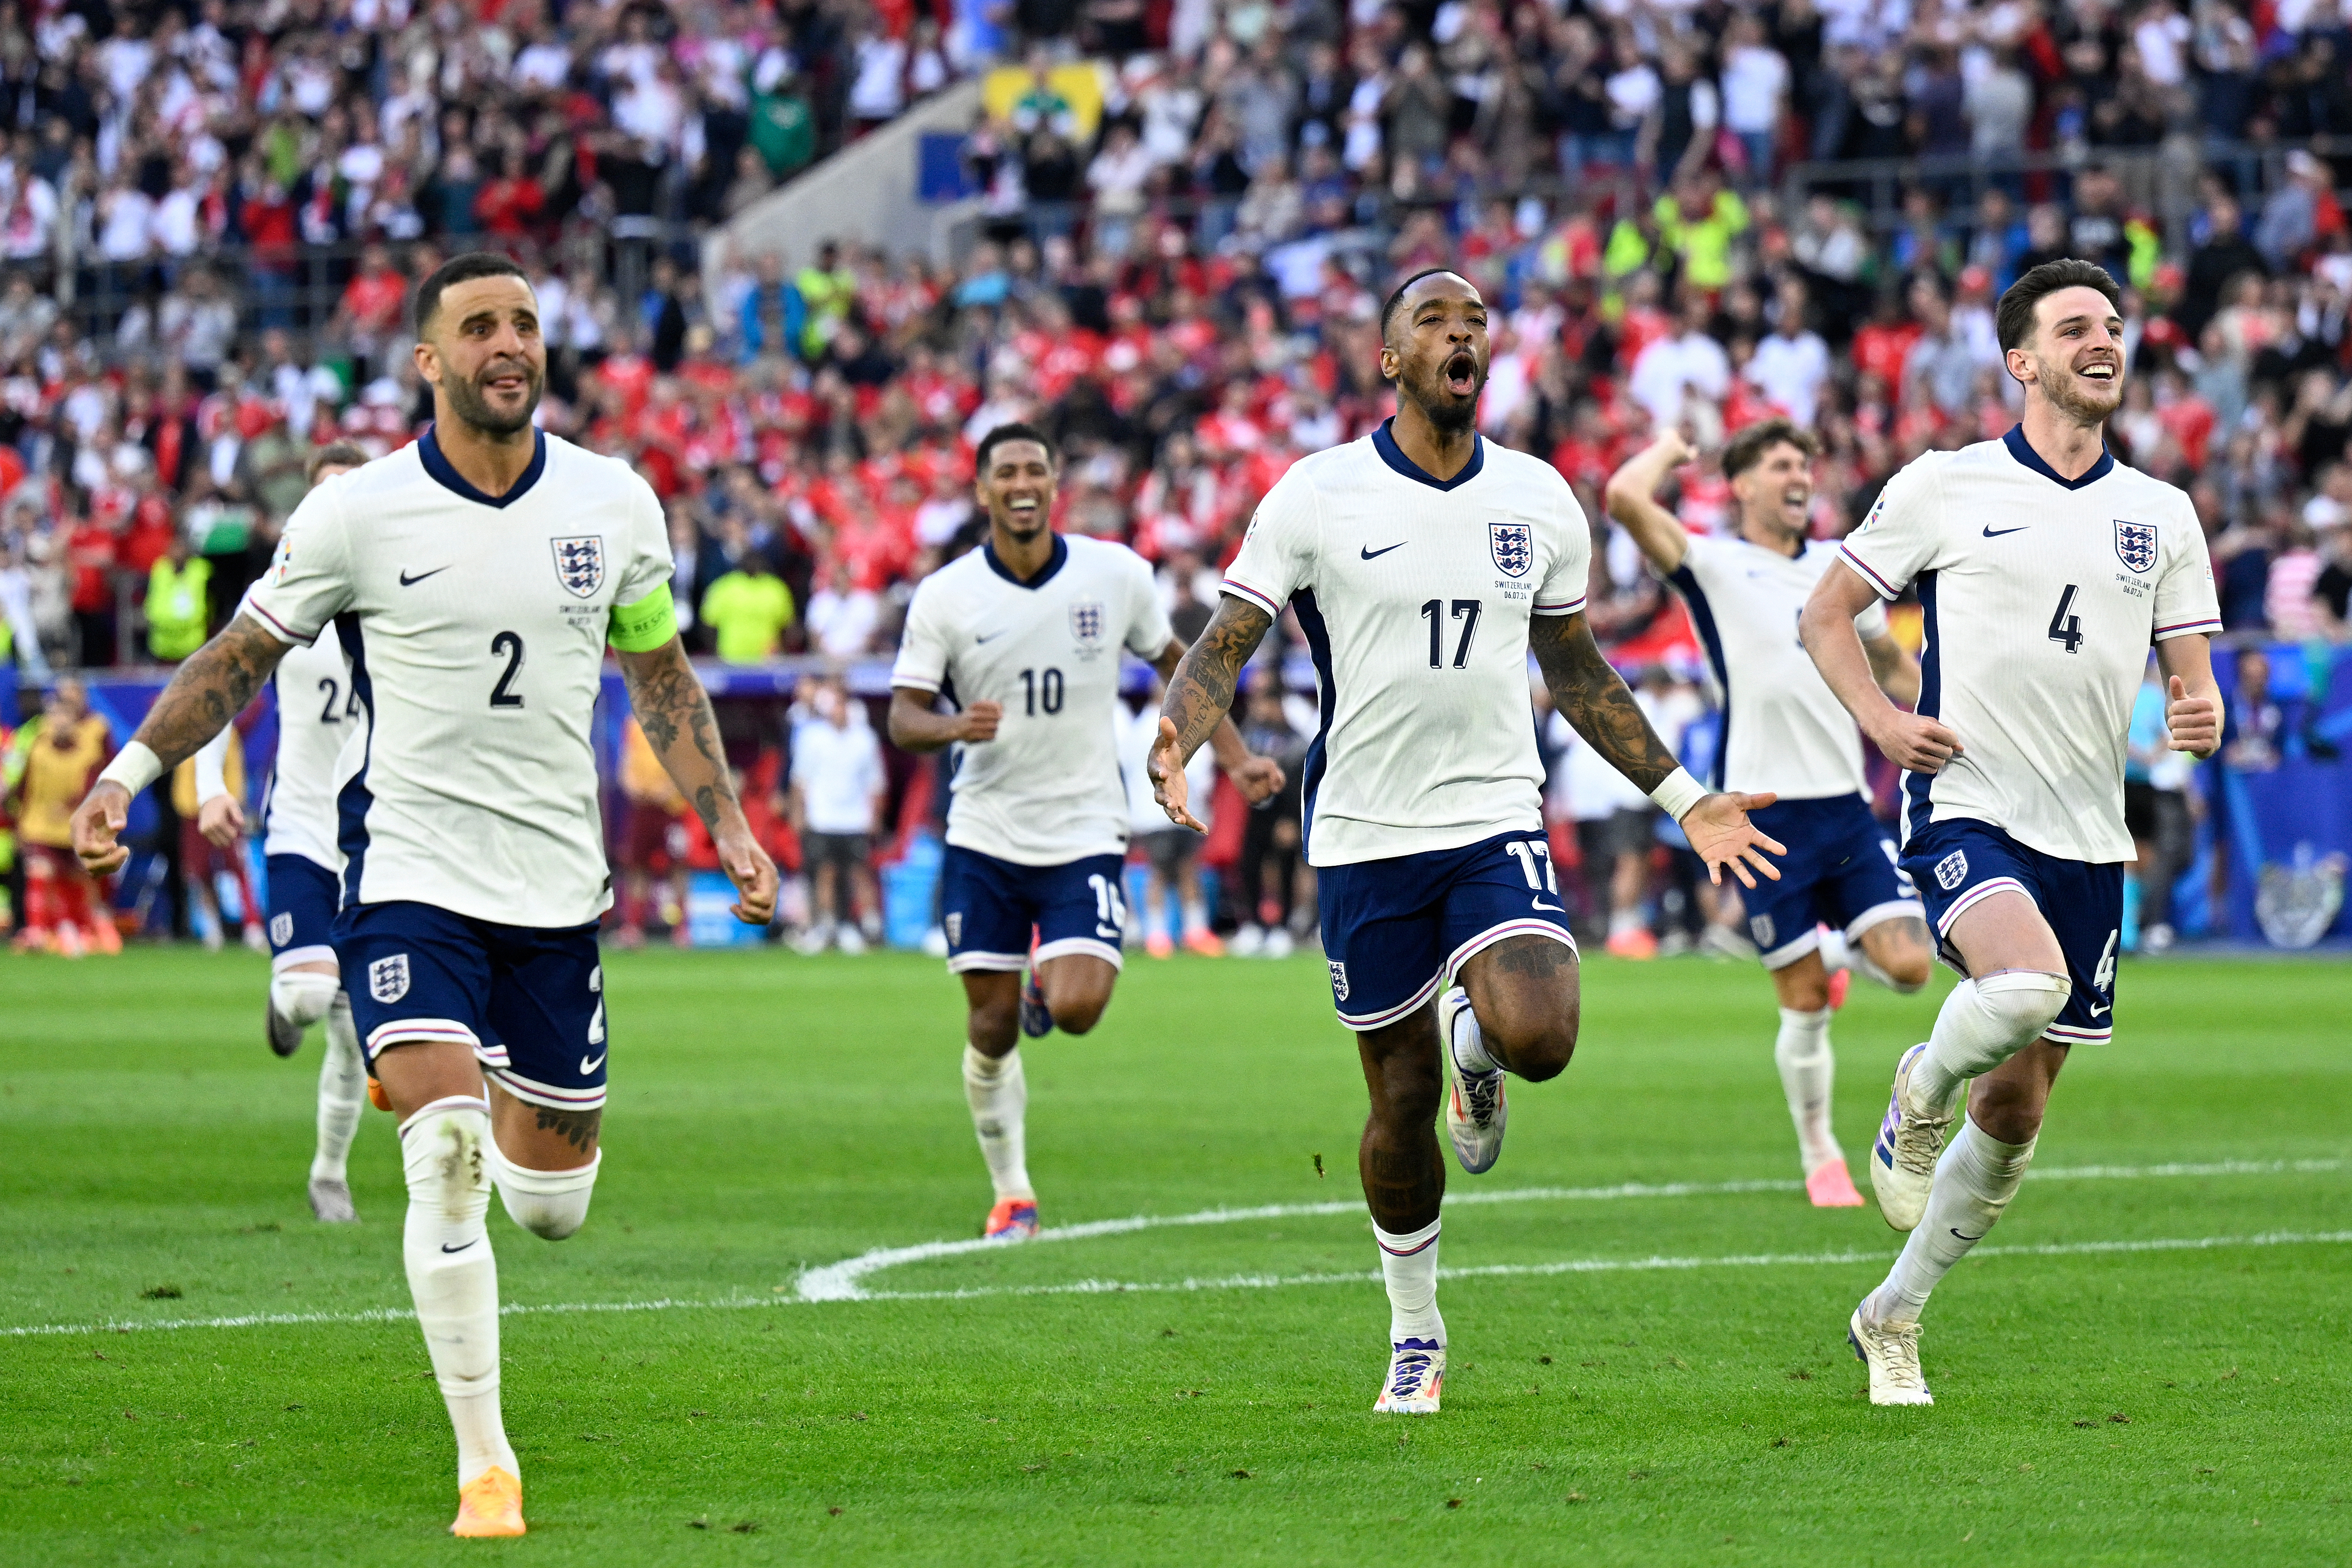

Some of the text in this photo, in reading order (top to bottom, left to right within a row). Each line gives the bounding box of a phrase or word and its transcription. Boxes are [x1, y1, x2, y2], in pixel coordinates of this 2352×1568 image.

[1495, 581, 1532, 590] SWITZERLAND
[1504, 591, 1527, 600] 06.07.24
[2116, 573, 2151, 591] SWITZERLAND
[2123, 585, 2142, 598] 06.07.24
[1422, 599, 1482, 668] 17
[2048, 584, 2083, 653] 4
[490, 631, 526, 708] 2
[1019, 668, 1063, 717] 10
[1505, 841, 1557, 895] 17
[2093, 929, 2118, 992] 4
